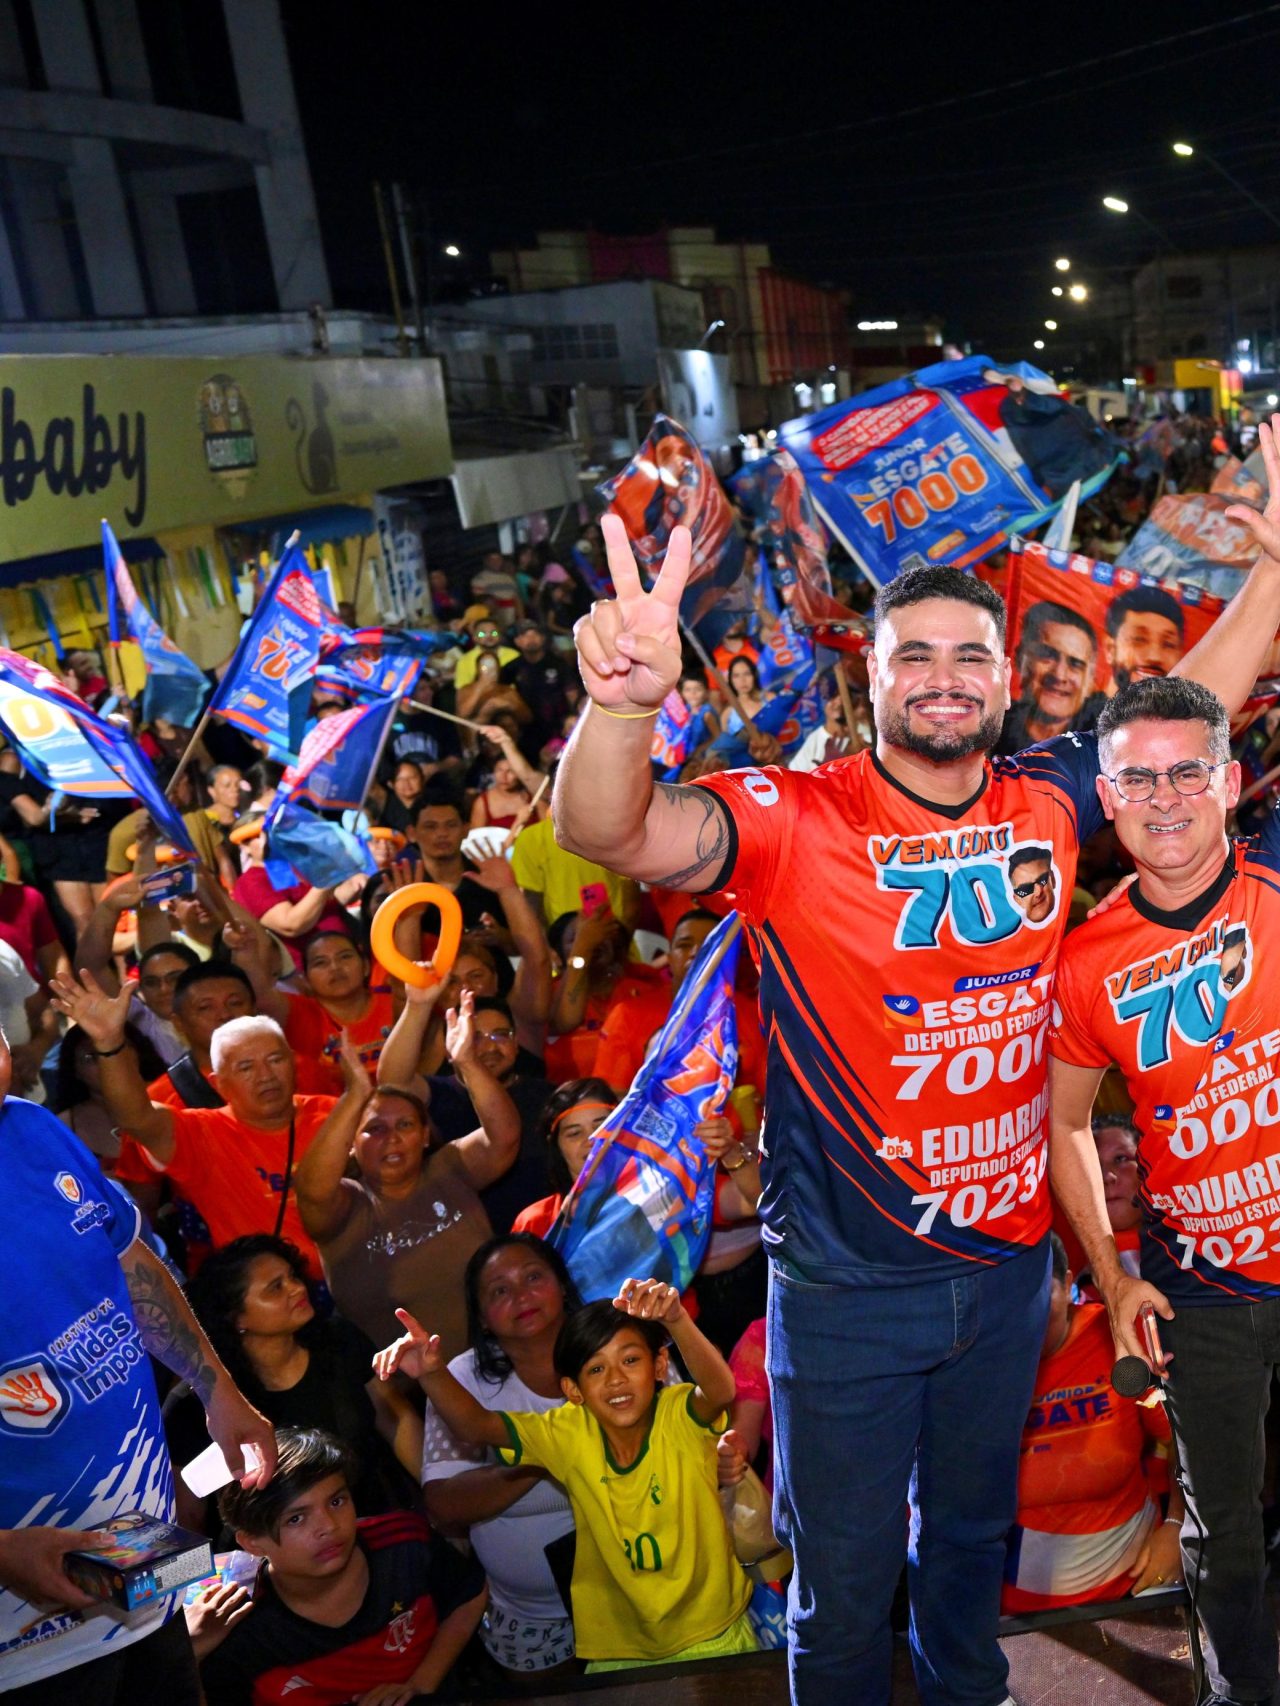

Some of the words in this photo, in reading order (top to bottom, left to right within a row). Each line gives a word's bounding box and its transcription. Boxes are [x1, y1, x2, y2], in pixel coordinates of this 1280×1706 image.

[2, 384, 146, 528] baby
[874, 438, 928, 472] JUNIOR
[861, 453, 989, 545] 7000
[871, 835, 955, 865] VEM
[883, 864, 1023, 948] 70
[964, 967, 1032, 990] JUNIOR
[1108, 946, 1184, 999] VEM
[1117, 962, 1229, 1069] 70
[904, 1019, 1004, 1052] DEPUTADO
[1208, 1061, 1275, 1105] FEDERAL
[885, 1143, 909, 1157] DR.
[930, 1155, 1008, 1188] DEPUTADO
[1182, 1210, 1245, 1233] DEPUTADO
[48, 1297, 115, 1355] INSTITUTO
